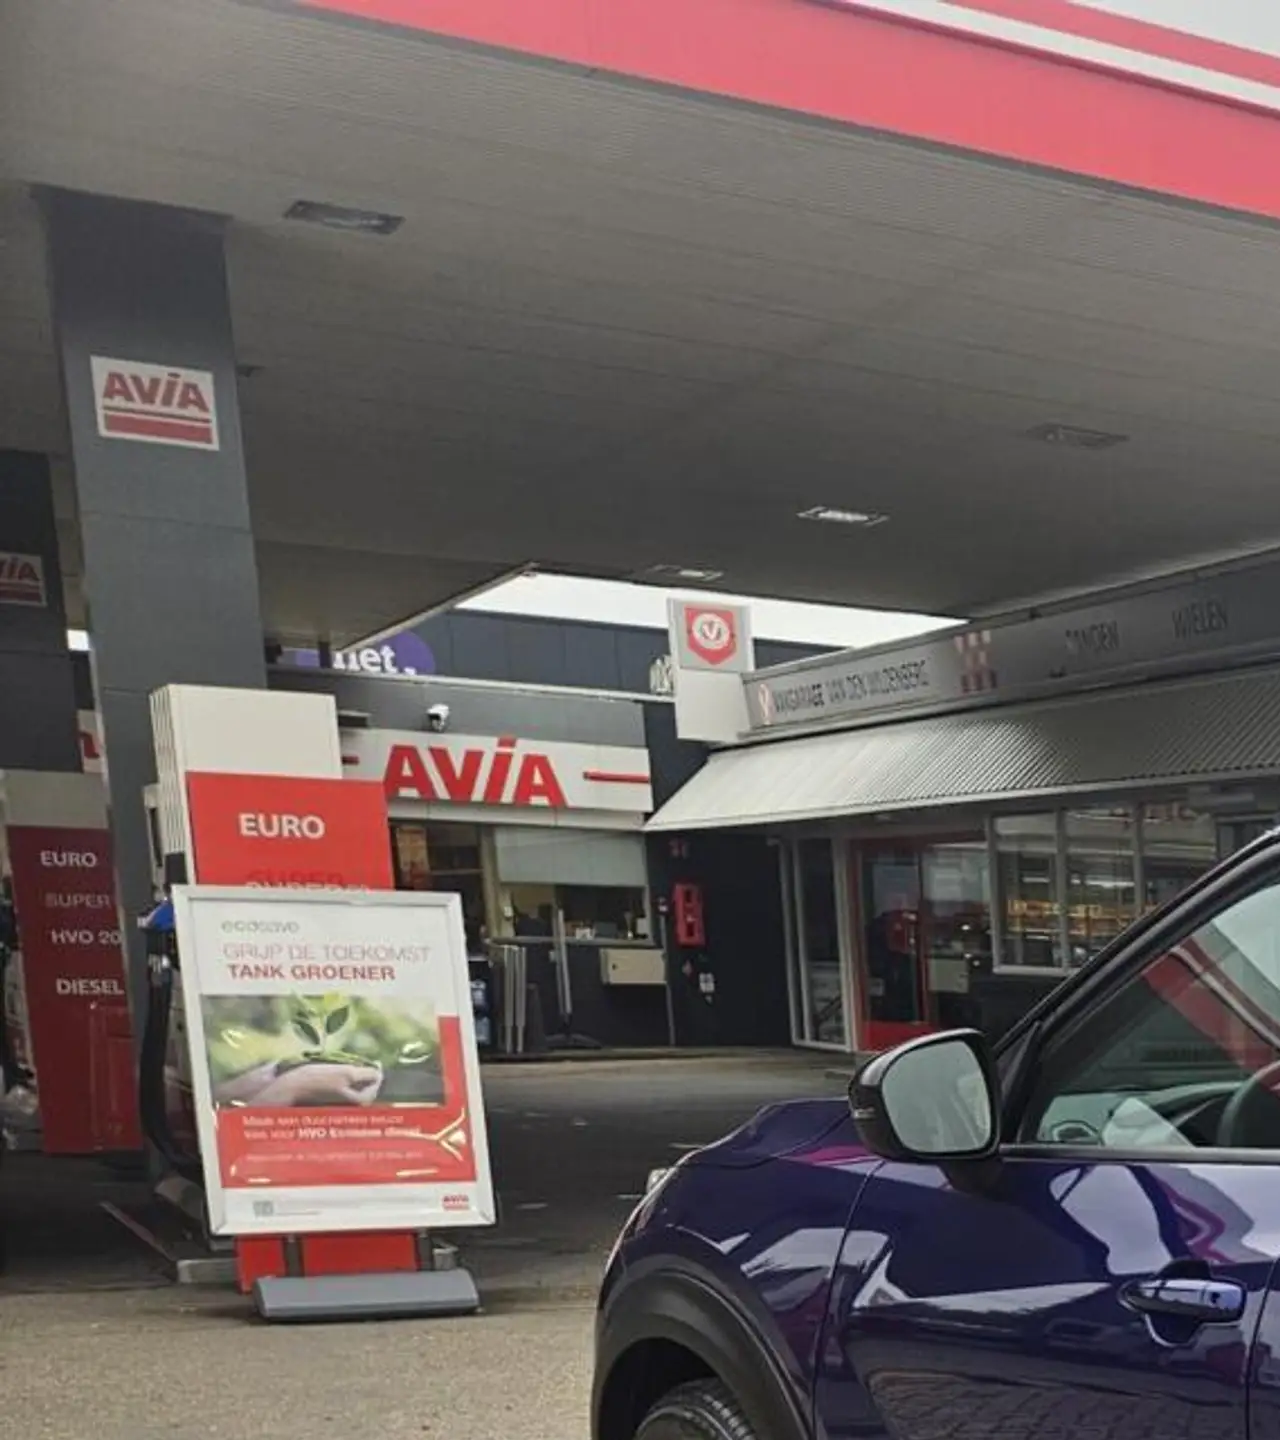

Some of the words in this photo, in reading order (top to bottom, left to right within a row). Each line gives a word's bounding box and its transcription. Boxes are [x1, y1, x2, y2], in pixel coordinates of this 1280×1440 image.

[102, 371, 211, 413] AVIA
[382, 736, 568, 807] AVIA
[238, 812, 325, 840] EURO
[40, 850, 98, 868] EURO
[51, 930, 94, 945] HVO
[289, 944, 316, 960] DE
[323, 944, 431, 963] TOEKOMST
[227, 963, 285, 980] TANK
[291, 964, 396, 981] GROENER
[56, 977, 126, 996] DIESEL
